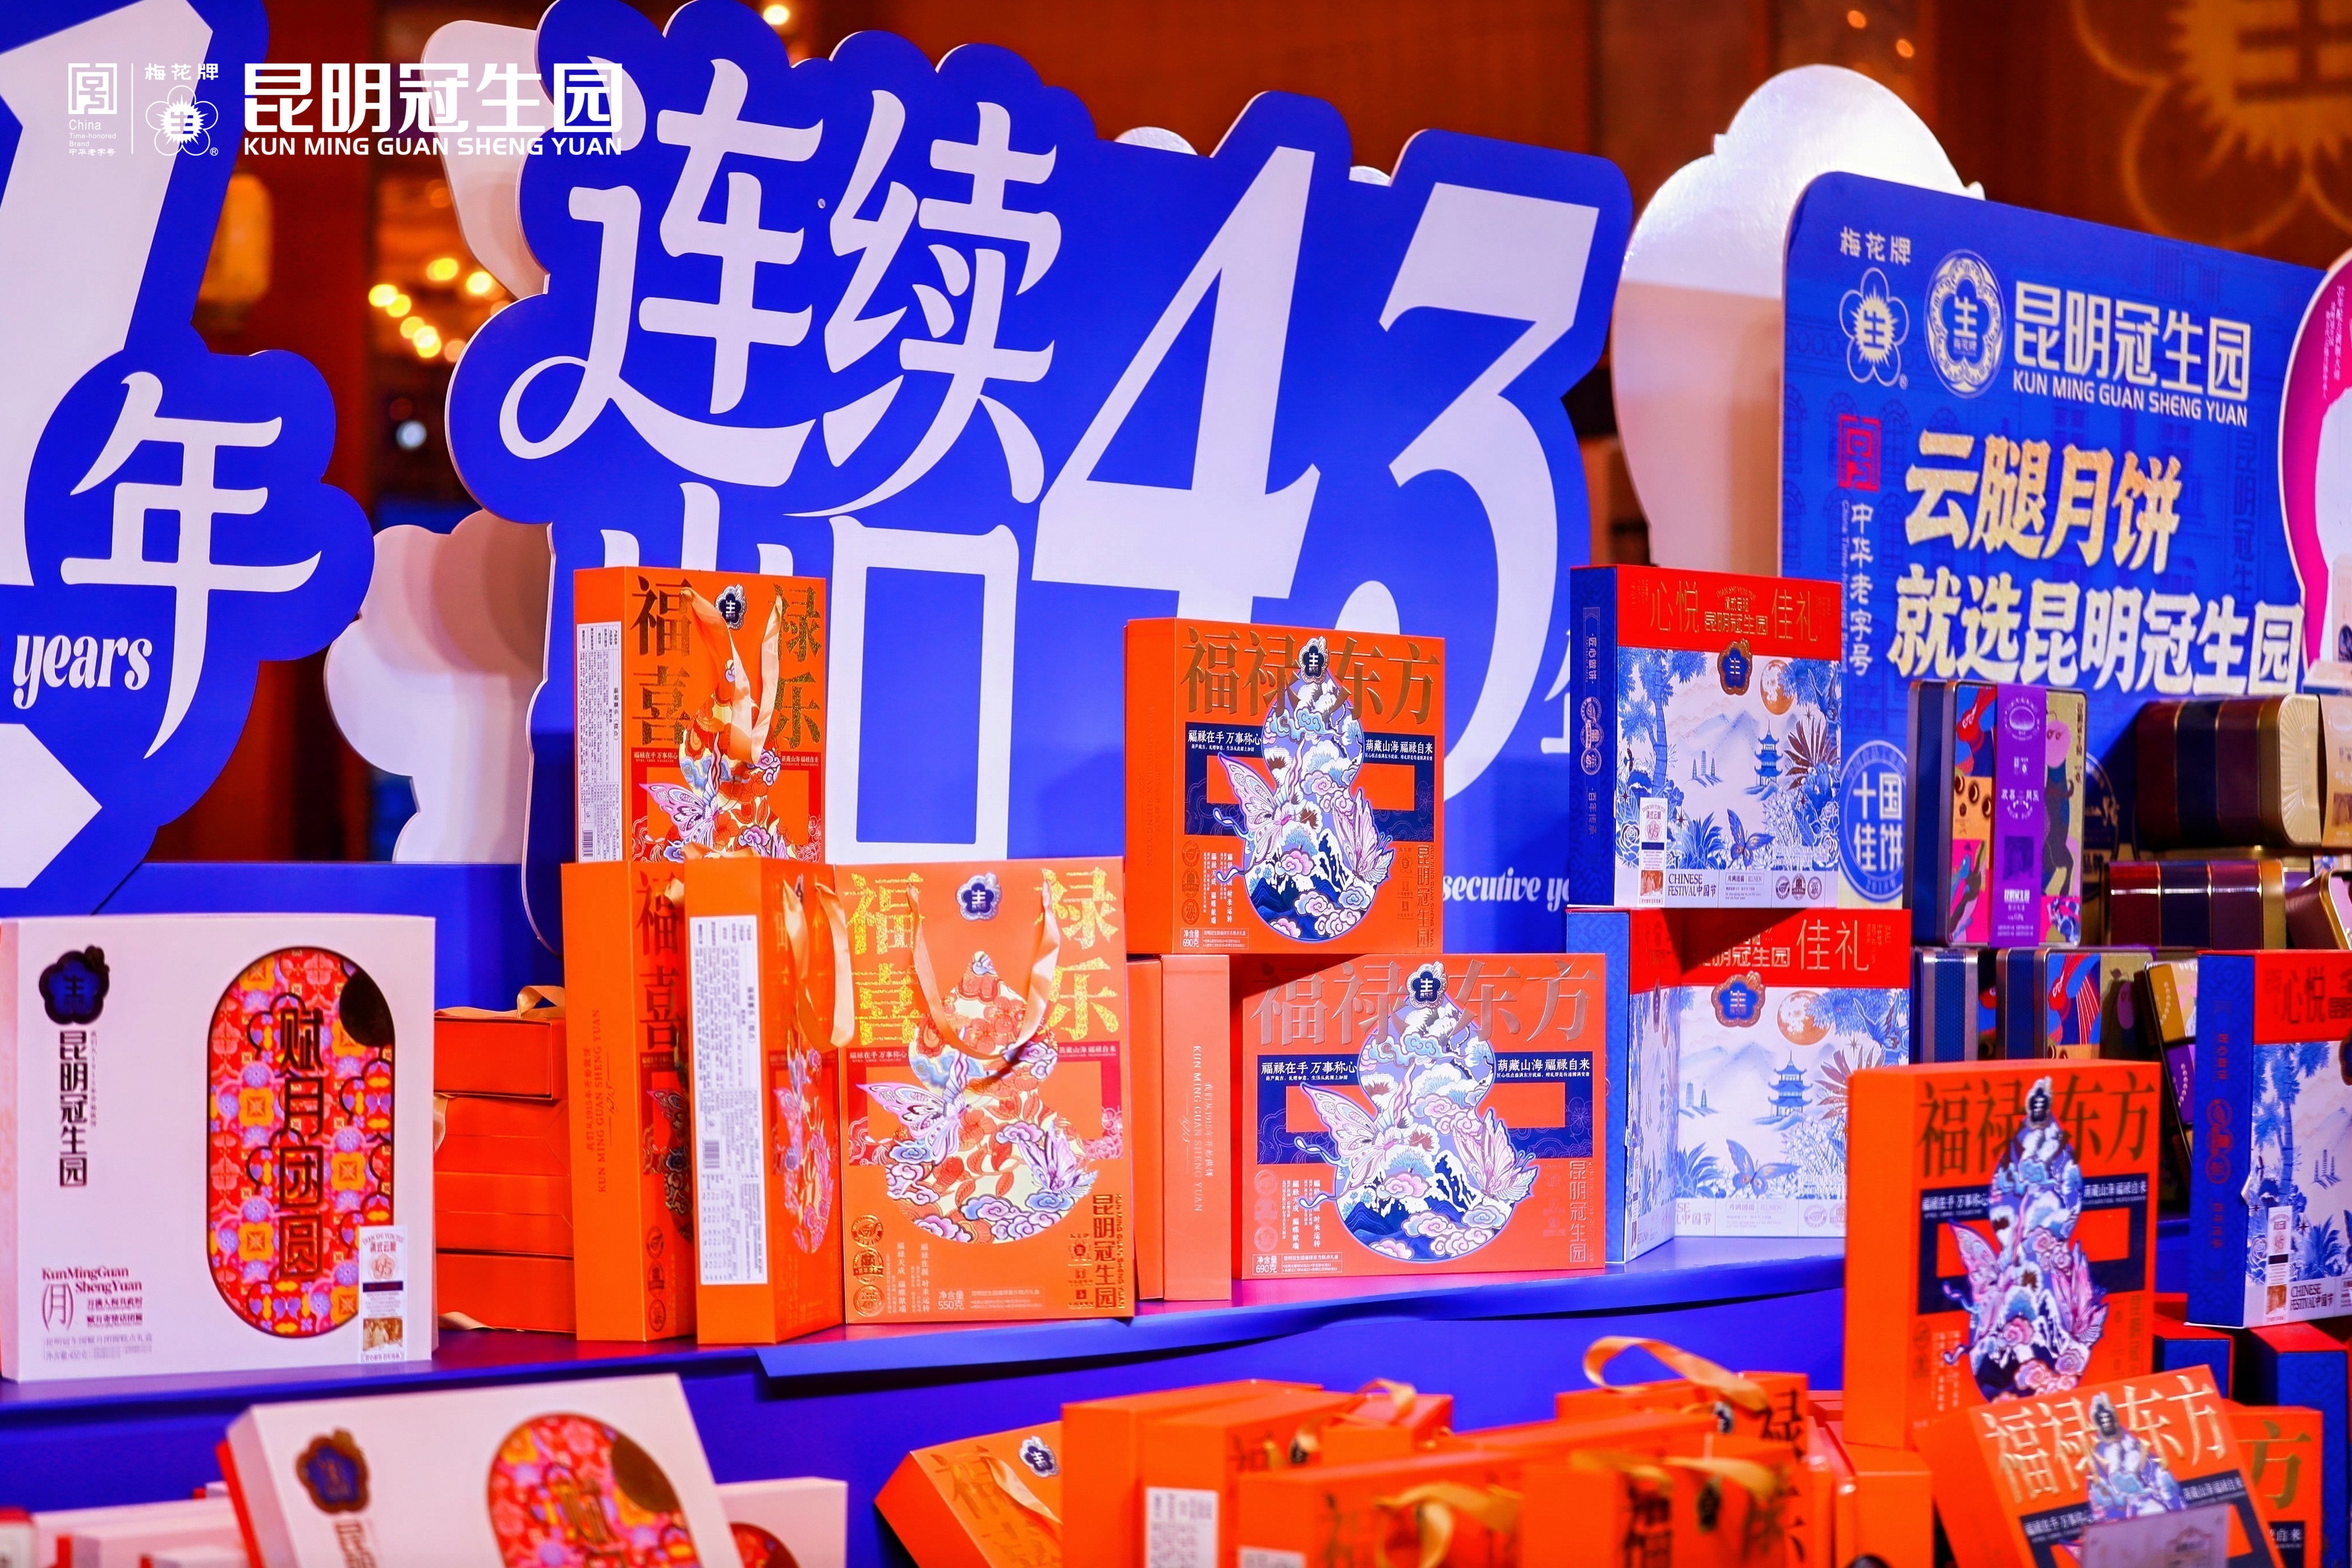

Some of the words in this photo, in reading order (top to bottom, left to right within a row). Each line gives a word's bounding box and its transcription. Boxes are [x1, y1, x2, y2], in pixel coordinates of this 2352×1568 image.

[1840, 225, 1911, 266] 梅花牌
[500, 57, 1064, 517] 连续
[2015, 280, 2252, 402] 昆明冠生园
[2013, 370, 2048, 396] KUN
[2052, 375, 2094, 403] MING
[2099, 381, 2144, 410] GUAN
[2149, 388, 2201, 421] SHENG
[2206, 399, 2247, 427] YUAN
[1905, 429, 2181, 573] 云腿月饼
[61, 371, 321, 759] 年
[1651, 580, 1699, 633] 心悦
[1772, 588, 1818, 641] 佳礼
[1850, 502, 1874, 677] 中华老字号
[631, 576, 693, 656] 福
[1704, 611, 1768, 636] 昆明冠生园
[1887, 563, 2303, 695] 就选昆明冠生园
[13, 630, 152, 709] years
[1181, 627, 1441, 725] 福禄东方
[1589, 636, 1597, 681] 匠心做饼
[632, 666, 692, 746] 喜
[772, 671, 821, 750] 乐
[1188, 730, 1224, 744] 福禄在手
[1225, 732, 1261, 745] 万事称心
[1365, 739, 1399, 753] 葫藏山海
[1400, 741, 1433, 755] 福禄自来
[1853, 771, 1903, 820] 十国
[1854, 823, 1903, 872] 佳饼
[1417, 845, 1430, 948] 昆明冠生园
[1668, 873, 1703, 885] CHINESE
[844, 872, 926, 956] 福
[1035, 866, 1119, 951] 禄
[1183, 929, 1199, 938] 净含量
[1183, 939, 1199, 948] 690克
[1797, 918, 1869, 971] 佳礼
[849, 960, 919, 1046] 喜
[1046, 958, 1120, 1042] 乐
[1249, 959, 1600, 1046] 福禄东方
[592, 1009, 601, 1043] YUAN
[593, 1046, 603, 1090] SHENG
[1193, 1045, 1202, 1069] KUN
[1261, 1061, 1308, 1075] 福禄在手
[1310, 1061, 1357, 1075] 万事称心
[1498, 1058, 1543, 1072] 葫藏山海
[1544, 1058, 1590, 1071] 福禄自来
[60, 1030, 87, 1187] 昆明冠生园
[595, 1092, 604, 1126] GUAN
[1193, 1073, 1202, 1102] MING
[280, 1007, 323, 1277] 赋月团圆
[1194, 1106, 1202, 1136] GUAN
[1919, 1073, 2155, 1178] 福禄东方
[596, 1129, 605, 1163] MING
[1194, 1140, 1203, 1178] SHENG
[598, 1167, 606, 1193] KUN
[1194, 1182, 1203, 1212] YUAN
[1570, 1160, 1587, 1263] 昆明冠生园
[42, 1265, 129, 1281] KunMingGuan
[1093, 1194, 1116, 1308] 昆明冠生园
[1256, 1255, 1277, 1265] 净含量
[1256, 1264, 1277, 1274] 690克
[75, 1281, 143, 1294] ShengYuan
[938, 1290, 964, 1300] 净含量
[938, 1300, 965, 1310] 550克
[2290, 1282, 2322, 1298] CHINESE
[1982, 1375, 2227, 1505] 福禄东方
